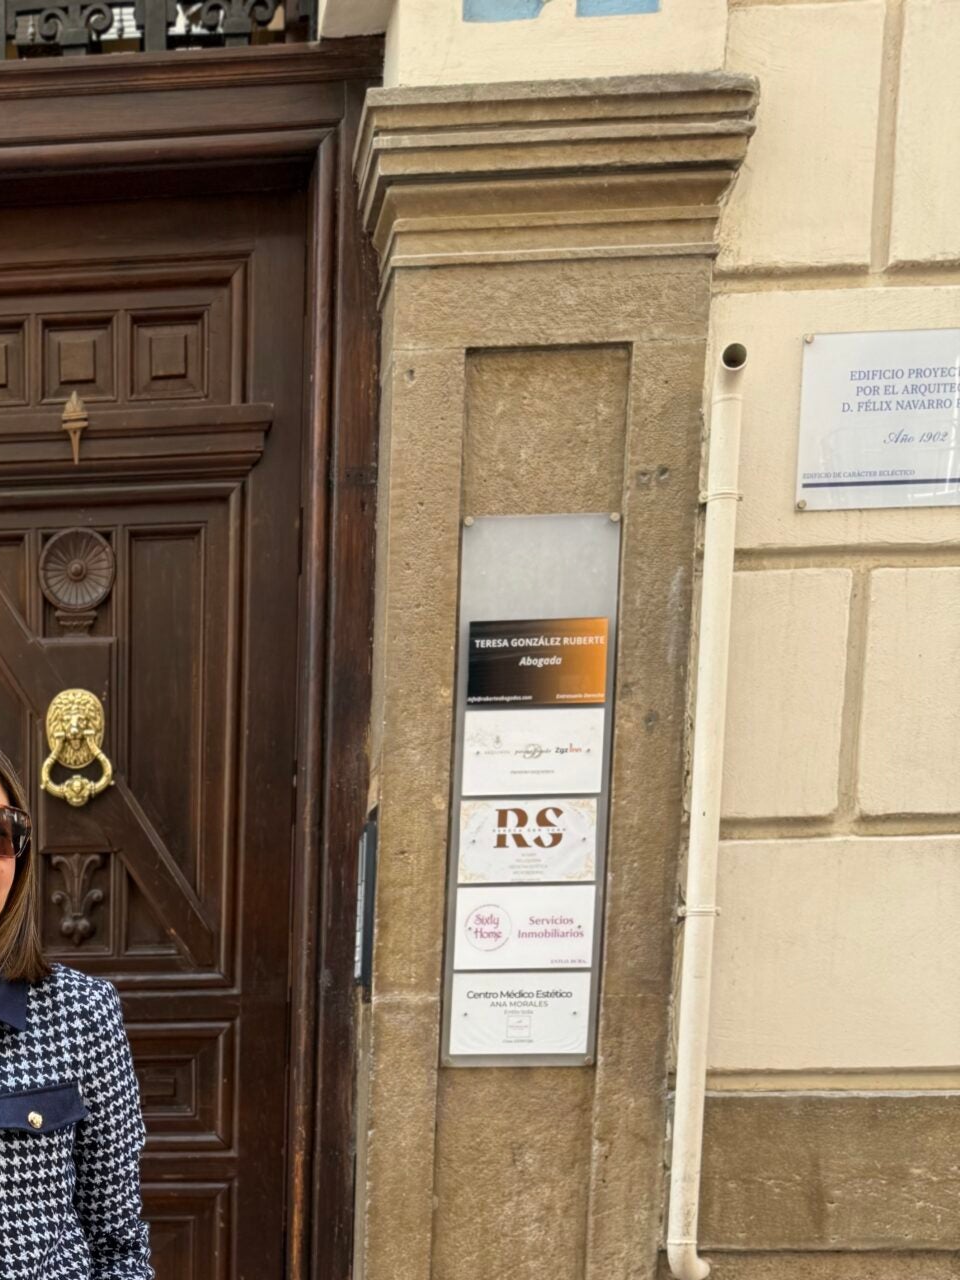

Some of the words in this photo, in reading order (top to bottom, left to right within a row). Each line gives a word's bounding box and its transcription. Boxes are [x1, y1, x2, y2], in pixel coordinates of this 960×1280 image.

[850, 369, 904, 381] EDIFICIO
[856, 385, 880, 396] POR
[884, 385, 898, 395] EL
[842, 402, 853, 412] D.
[857, 399, 892, 412] FÉLIX
[895, 399, 952, 411] NAVARRO
[883, 428, 915, 443] Año
[918, 431, 948, 443] 1902
[475, 639, 509, 648] TERESA
[511, 636, 561, 647] GONZÁLEZ
[563, 635, 605, 645] RUBERTE
[519, 655, 562, 667] Abogada
[493, 807, 564, 848] RS
[529, 915, 574, 925] Servicios
[518, 929, 584, 939] Inmobiliarios
[466, 990, 498, 999] Centro
[500, 989, 534, 998] Médico
[536, 988, 572, 998] Estético
[509, 1000, 549, 1008] MORALES
